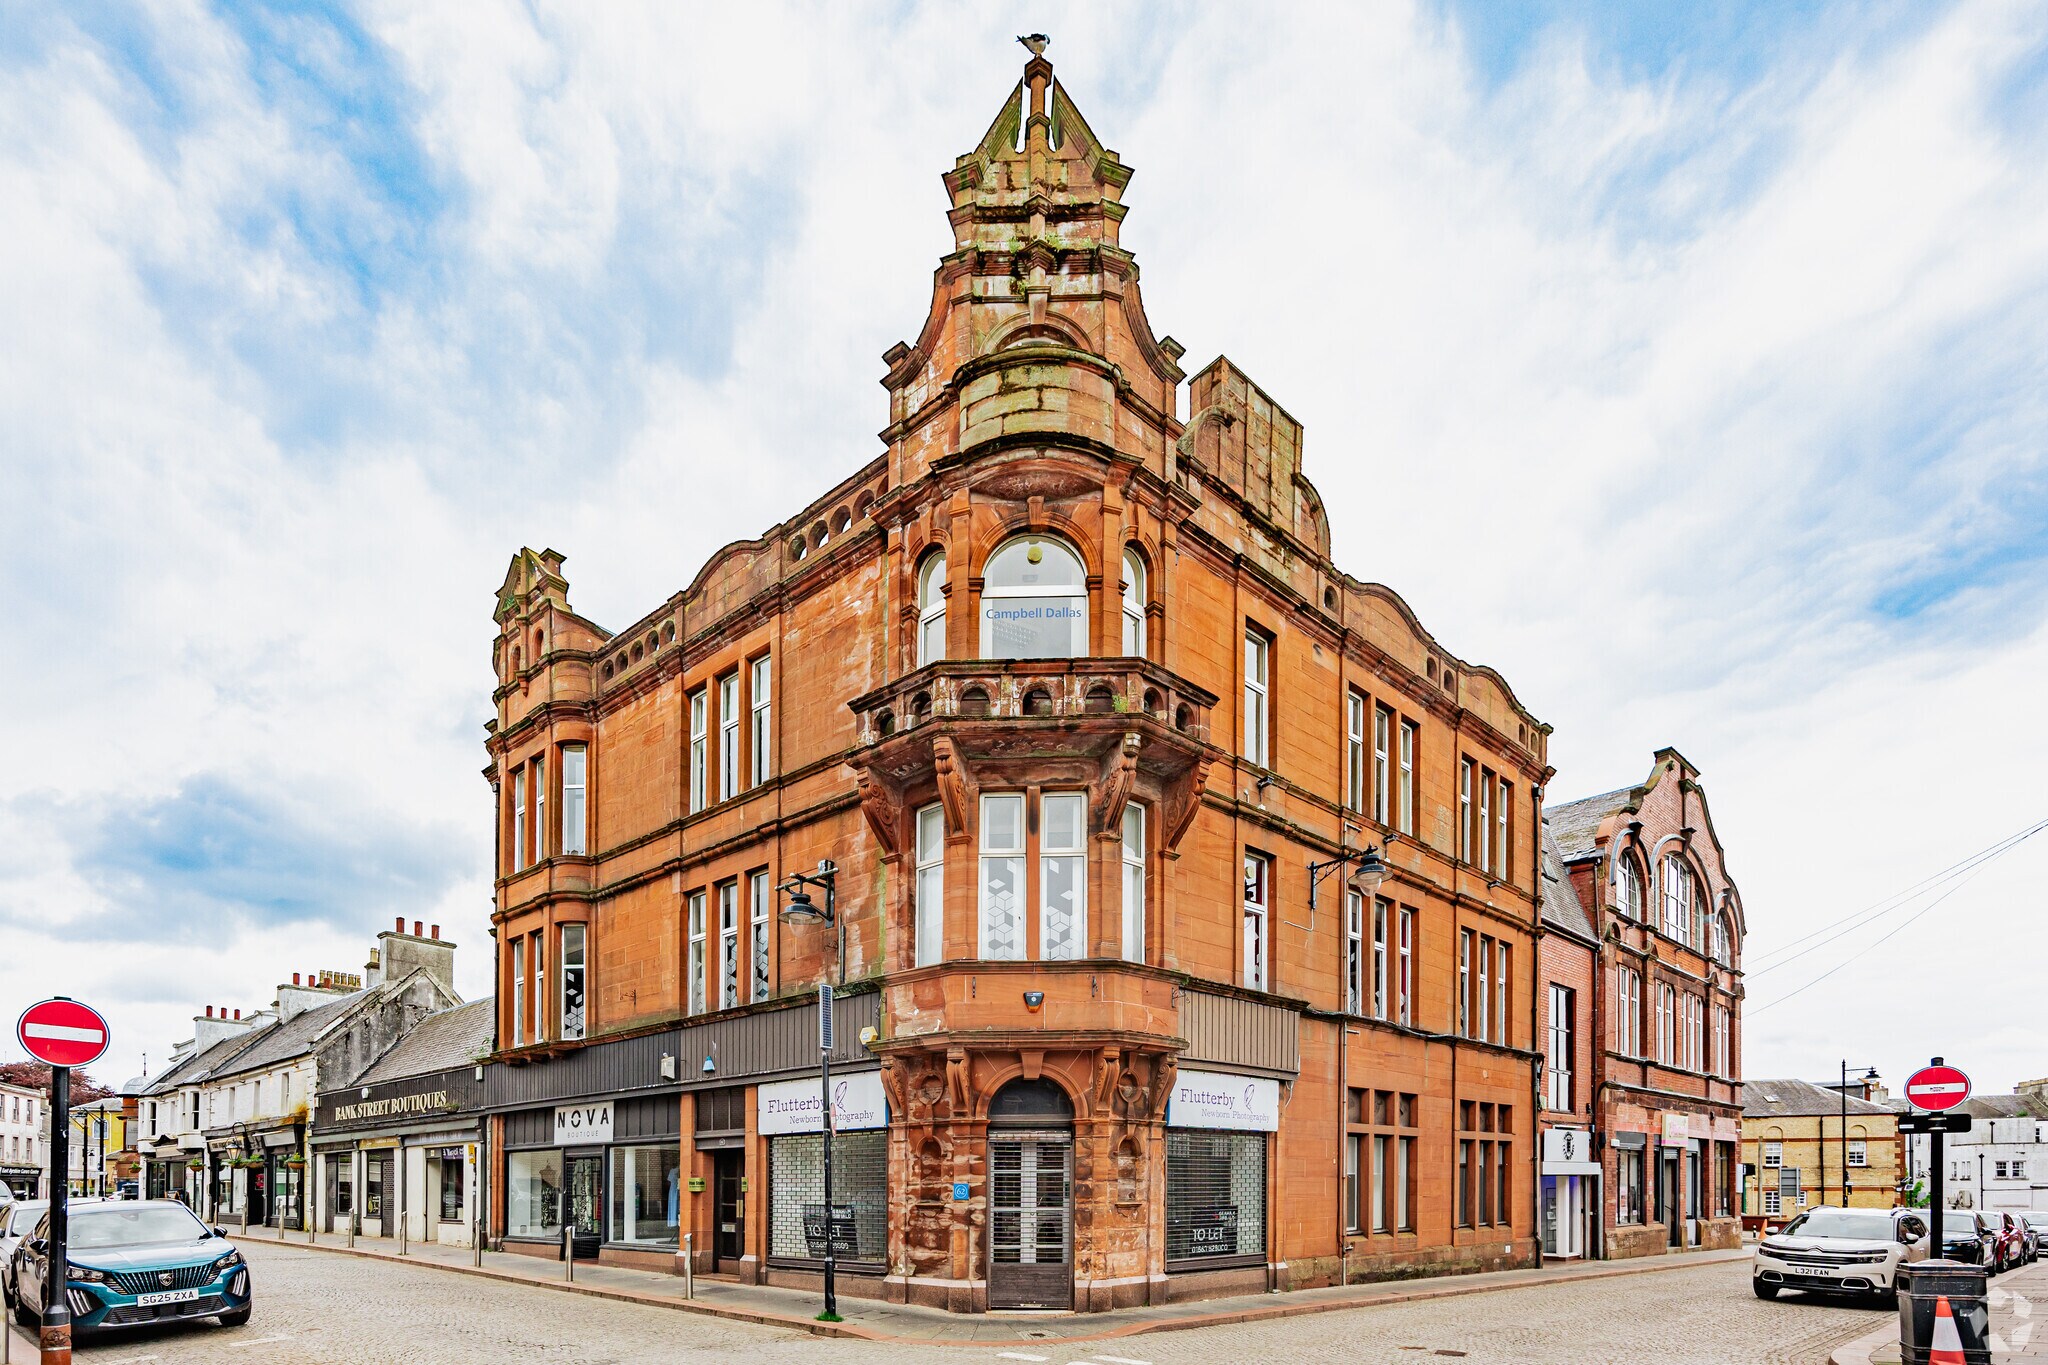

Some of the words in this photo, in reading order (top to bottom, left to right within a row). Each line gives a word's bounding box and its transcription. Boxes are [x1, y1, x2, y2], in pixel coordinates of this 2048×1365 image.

[986, 608, 1042, 621] Campbell
[1046, 607, 1082, 618] Dallas
[335, 1105, 357, 1121] BANK
[357, 1099, 390, 1119] STREET
[391, 1090, 447, 1113] BOUTIQUES
[1180, 1088, 1235, 1109] Flutterby
[557, 1107, 609, 1128] NOVA
[789, 1115, 822, 1124] Newborn
[835, 1110, 874, 1123] otography
[1201, 1109, 1230, 1118] Newborn
[1232, 1110, 1269, 1123] Photography
[567, 1130, 599, 1139] BOUTIQUE
[1192, 1228, 1206, 1242] TO
[1208, 1227, 1224, 1240] LET
[1795, 1267, 1812, 1275] L321
[1813, 1268, 1829, 1276] EAN
[142, 1293, 171, 1304] SG25
[173, 1291, 194, 1301] ZXA
